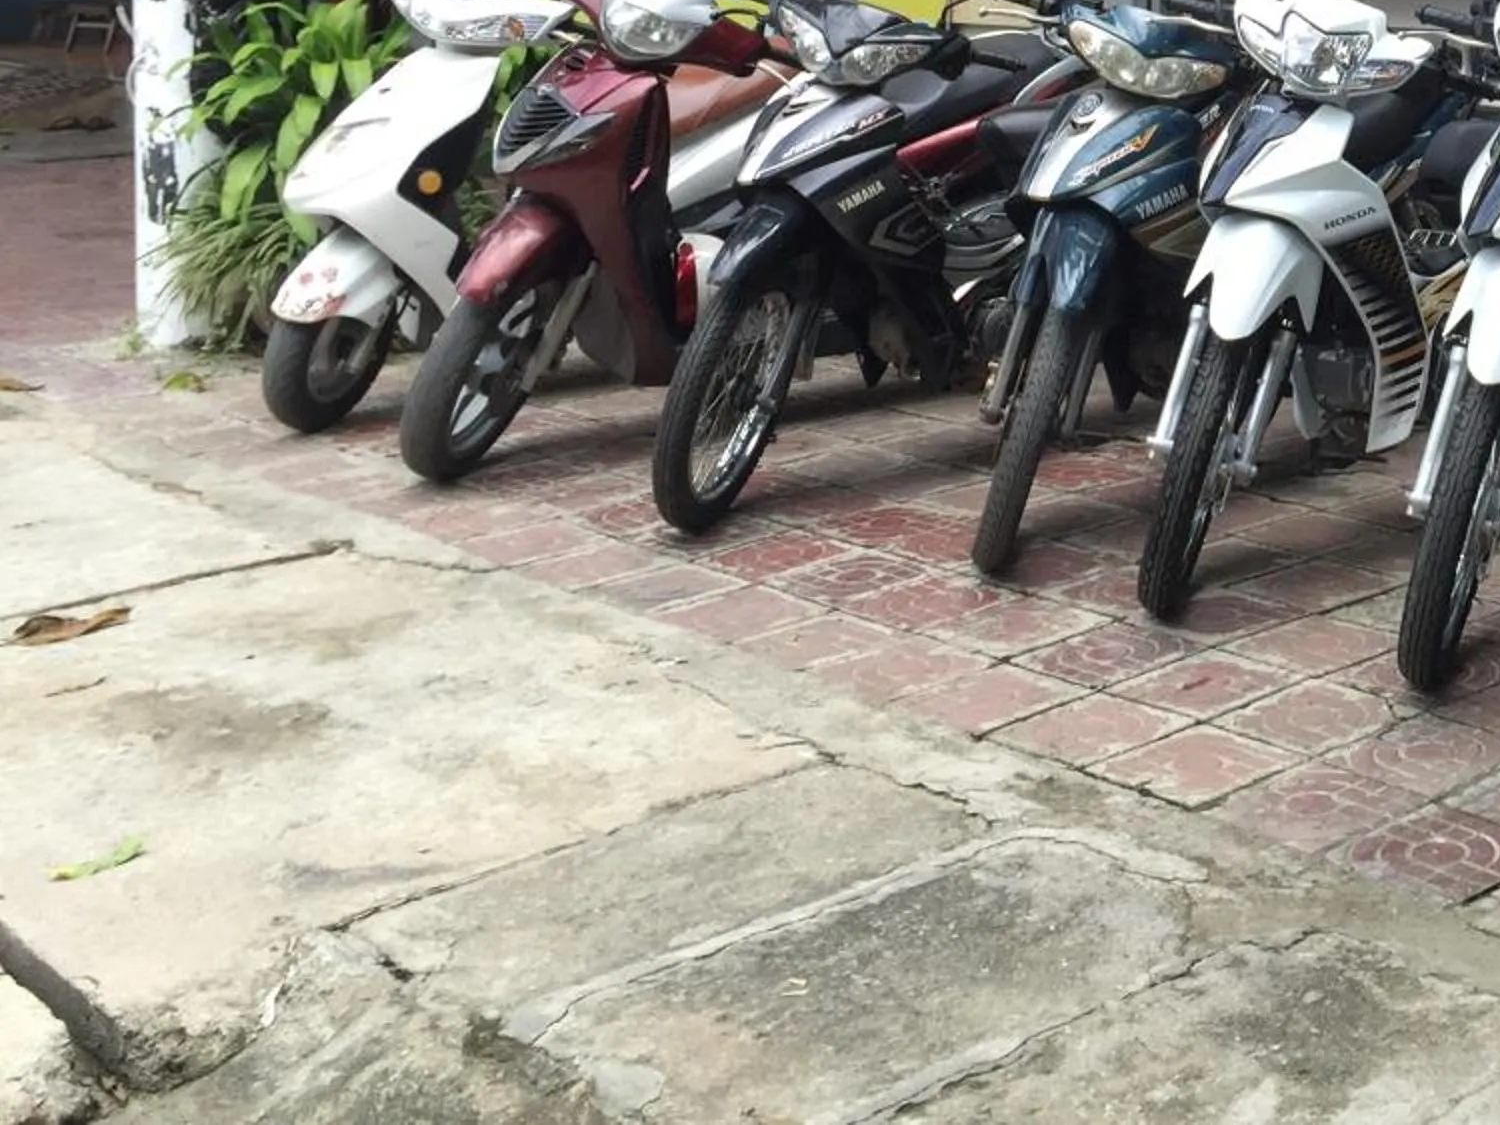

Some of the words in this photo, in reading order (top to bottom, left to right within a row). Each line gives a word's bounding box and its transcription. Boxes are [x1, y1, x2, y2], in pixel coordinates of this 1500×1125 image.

[837, 179, 886, 213] YAMAHA
[1136, 183, 1190, 220] YAMAHA
[1324, 206, 1376, 230] HONDA
